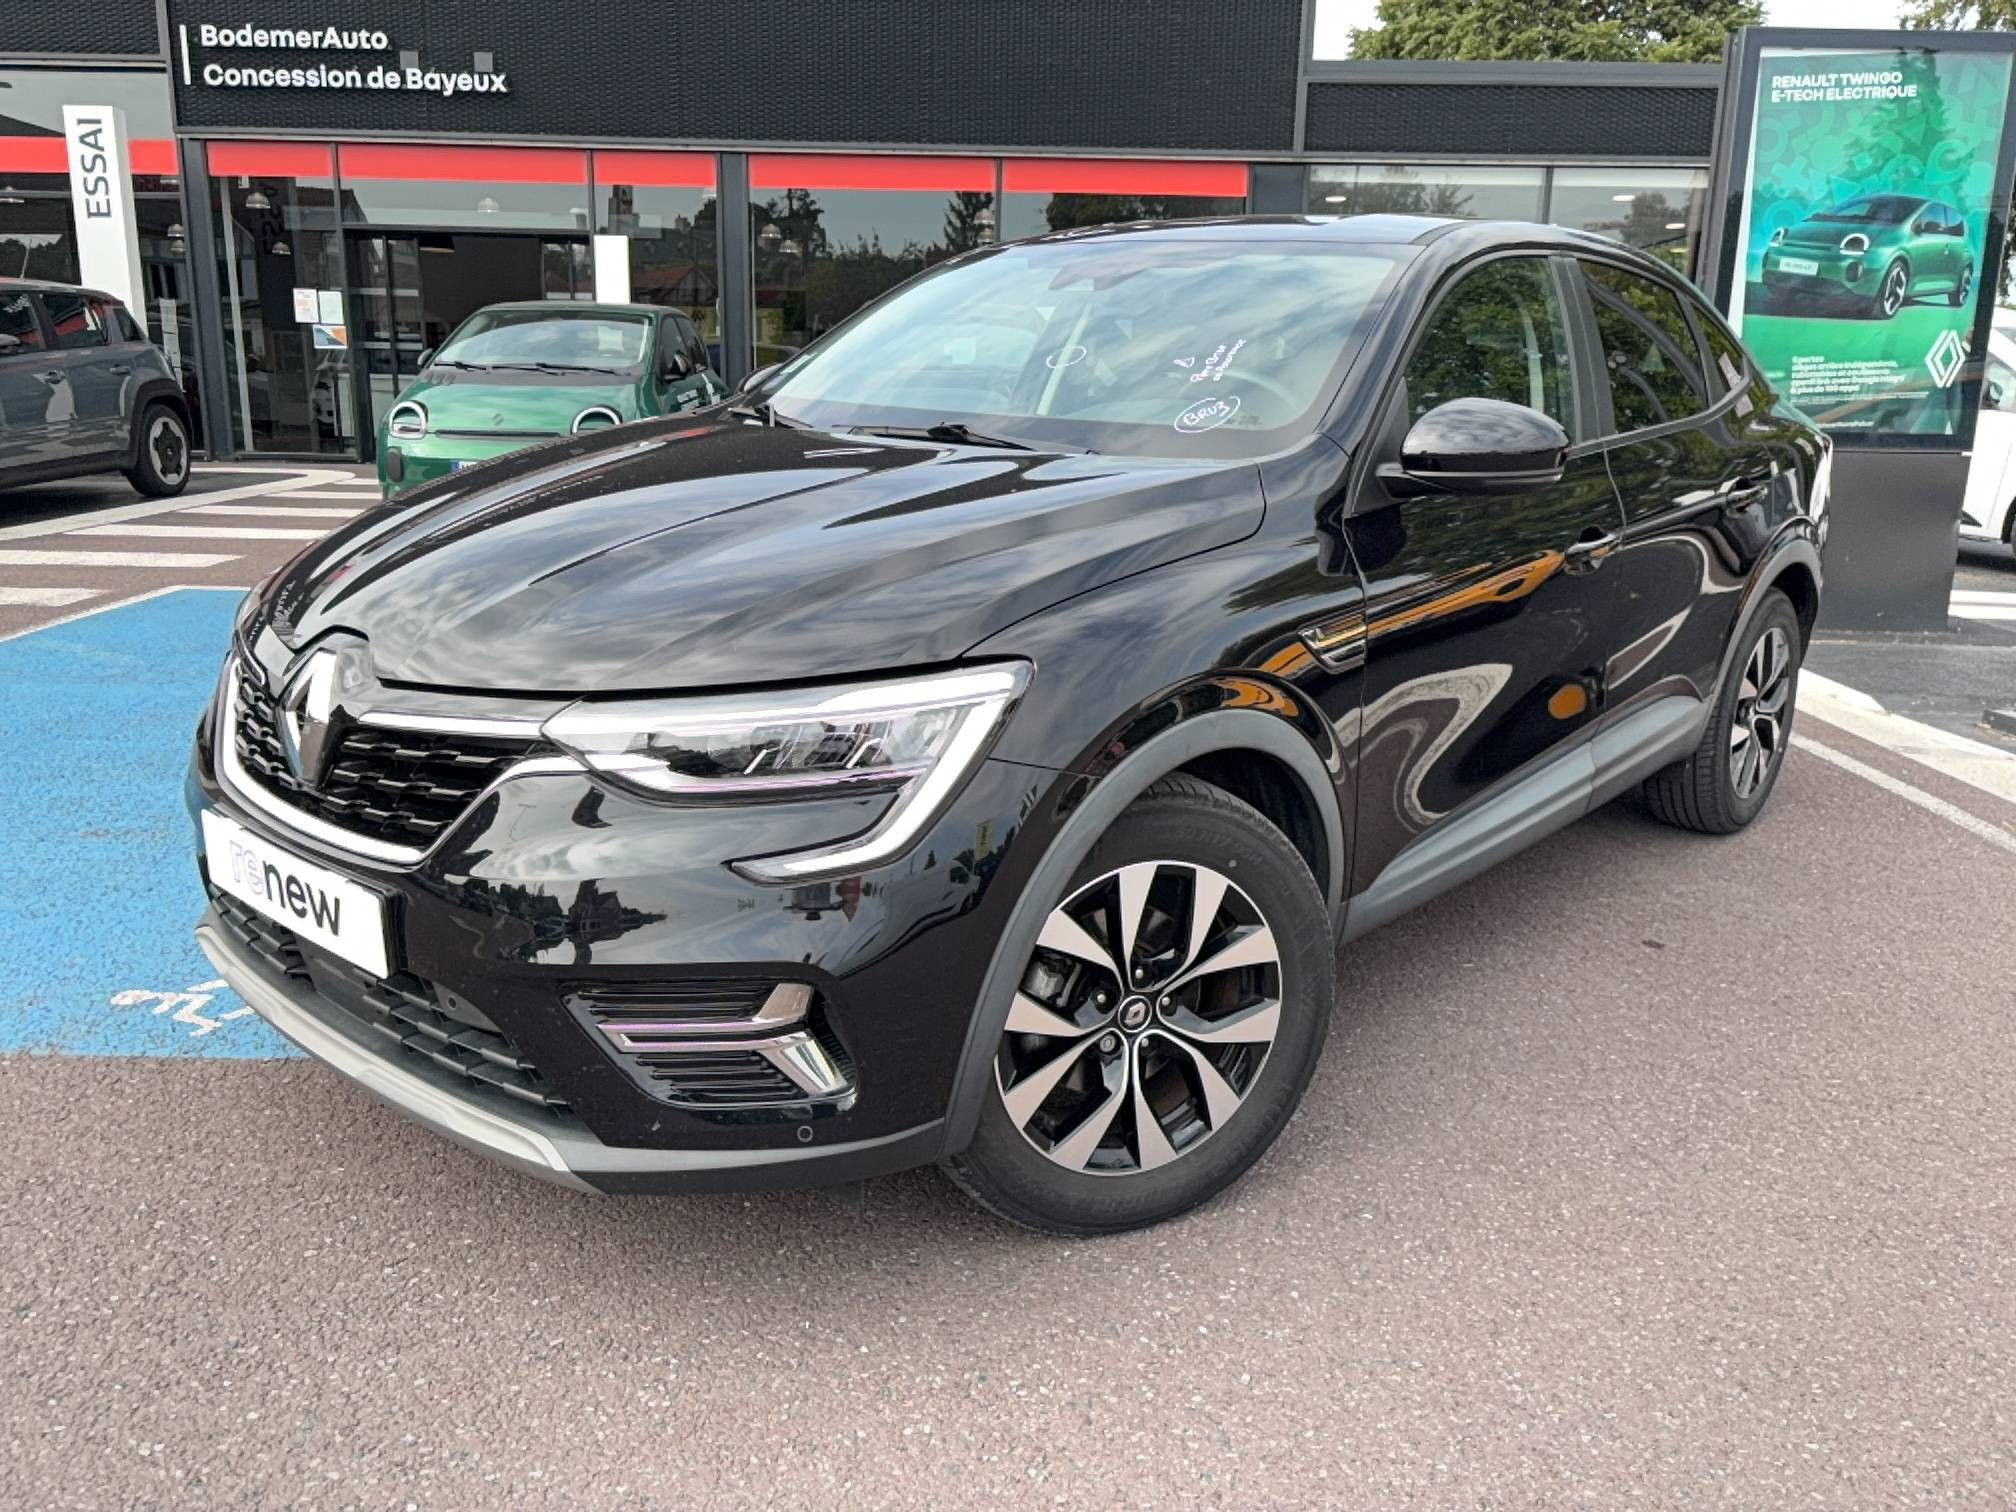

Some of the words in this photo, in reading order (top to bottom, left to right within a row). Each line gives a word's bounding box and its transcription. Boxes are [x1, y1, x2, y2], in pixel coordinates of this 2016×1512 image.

[200, 24, 389, 50] BodemerAuto
[203, 63, 362, 88] Concession
[366, 65, 401, 89] de
[404, 67, 508, 97] Bayeux
[1771, 74, 1838, 89] RENAULT
[1840, 71, 1903, 86] TWINGO
[1771, 88, 1824, 103] E-TECH
[76, 118, 112, 219] ESSAI
[229, 839, 340, 937] renew
